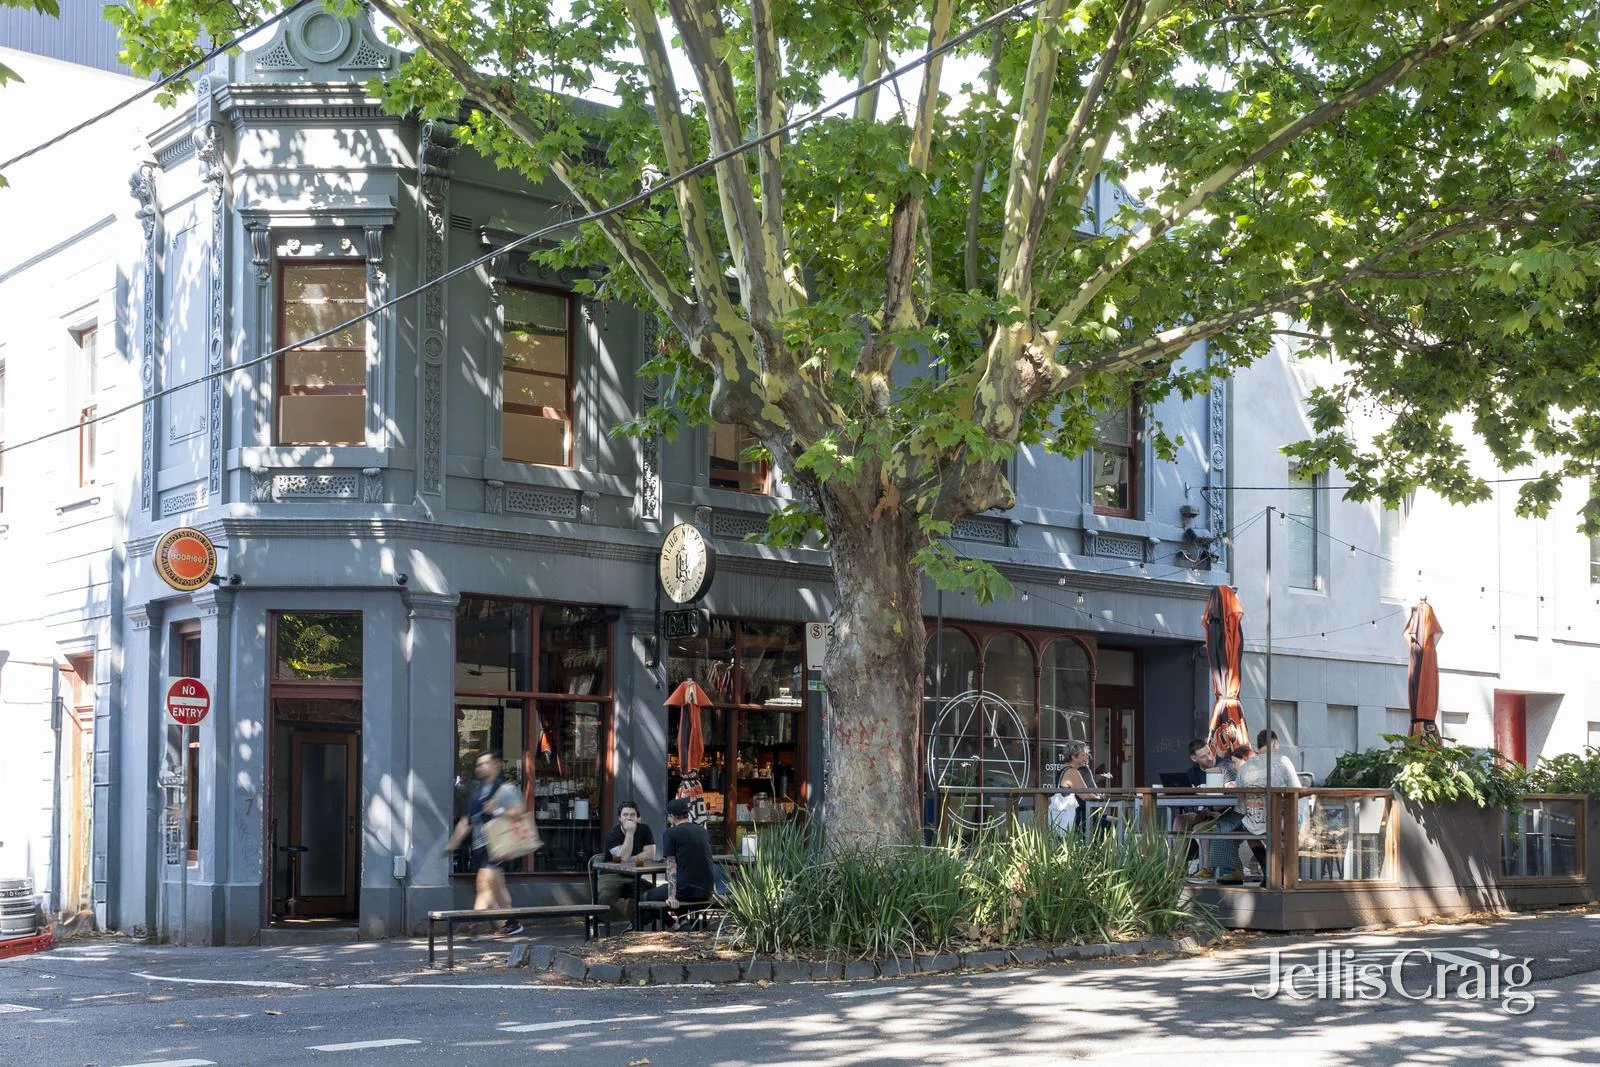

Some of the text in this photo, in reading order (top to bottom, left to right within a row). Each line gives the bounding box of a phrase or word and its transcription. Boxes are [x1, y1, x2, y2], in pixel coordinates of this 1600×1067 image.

[663, 532, 679, 562] PLUG
[668, 612, 697, 636] BAR
[182, 685, 196, 695] NO
[172, 707, 204, 718] ENTRY
